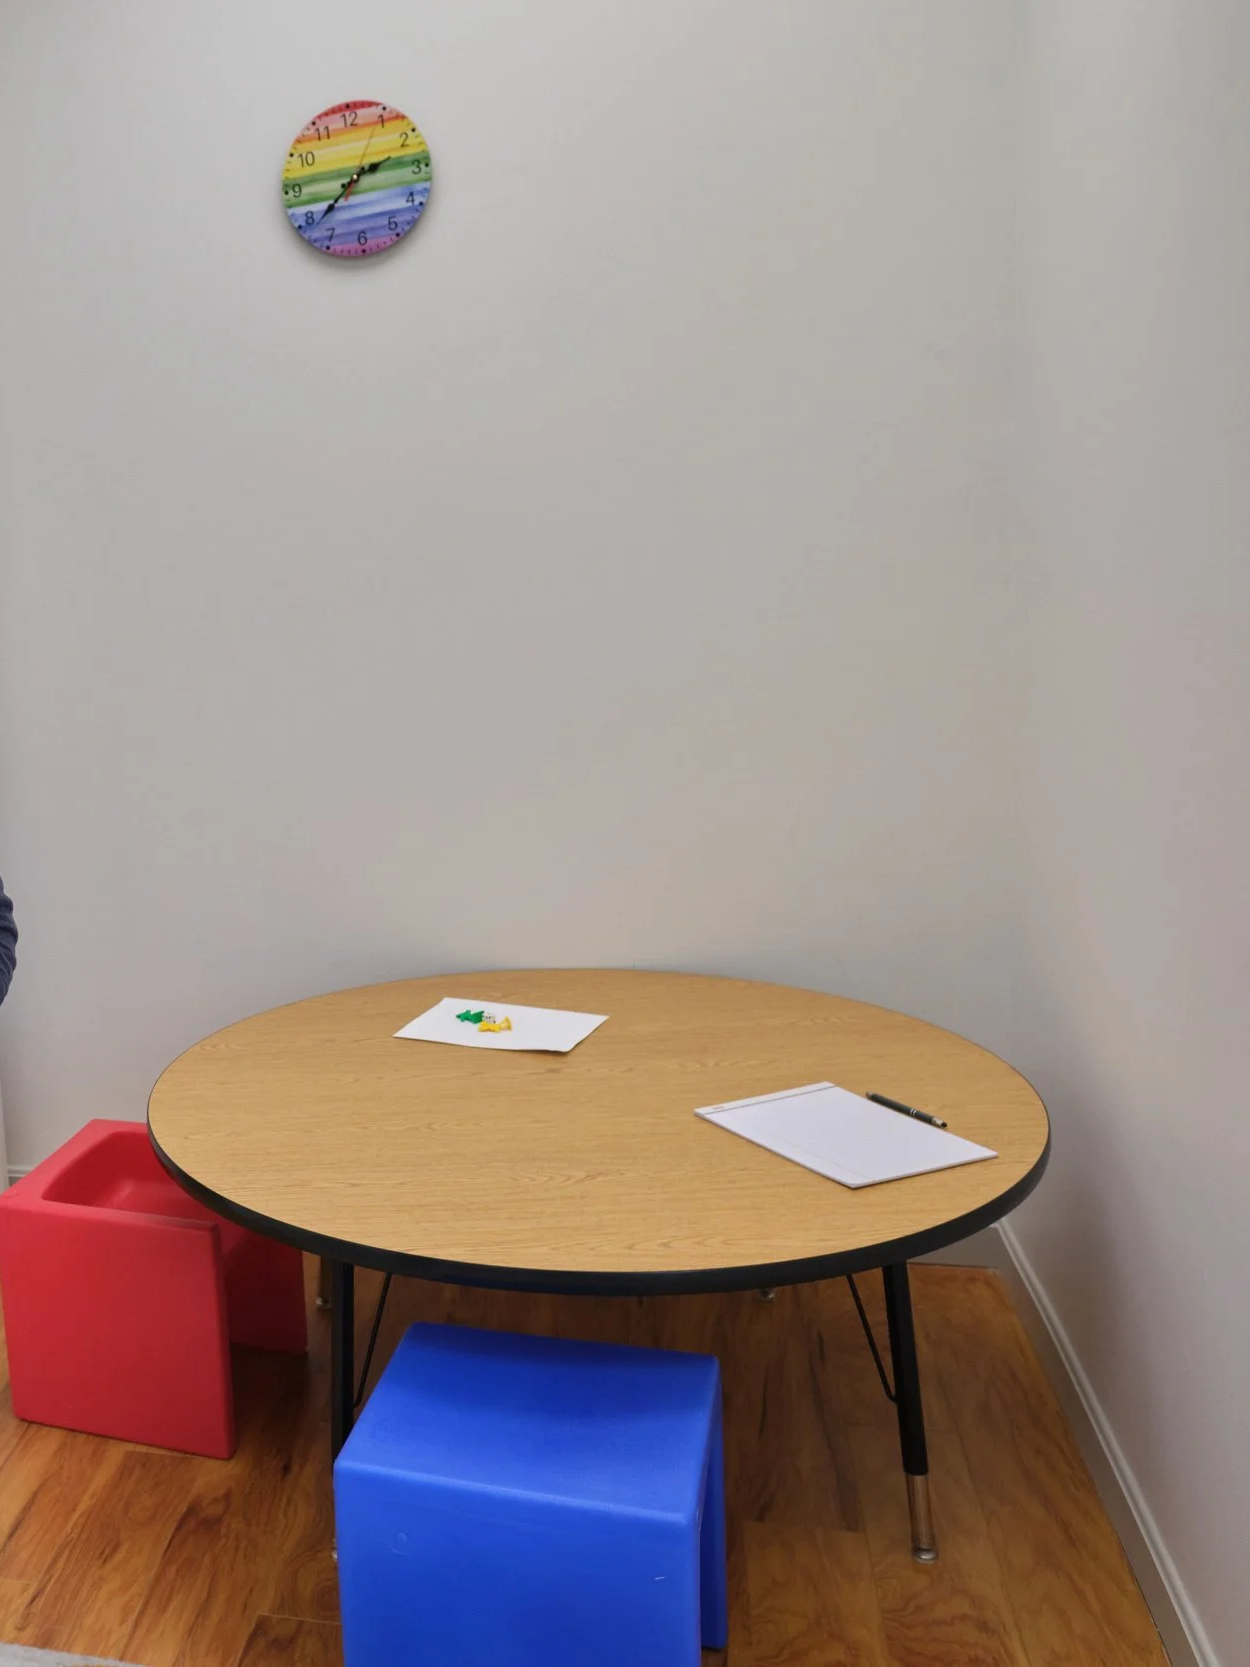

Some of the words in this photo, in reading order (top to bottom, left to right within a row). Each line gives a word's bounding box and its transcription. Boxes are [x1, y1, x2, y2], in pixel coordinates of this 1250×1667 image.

[340, 110, 358, 128] 12
[377, 114, 385, 128] 1
[314, 126, 330, 141] 11
[399, 132, 409, 148] 2
[297, 152, 315, 167] 10
[411, 159, 422, 175] 3
[292, 183, 302, 198] 9
[406, 191, 415, 205] 4
[304, 210, 315, 226] 8
[387, 216, 398, 231] 5
[326, 227, 335, 242] 7
[357, 230, 368, 246] 6
